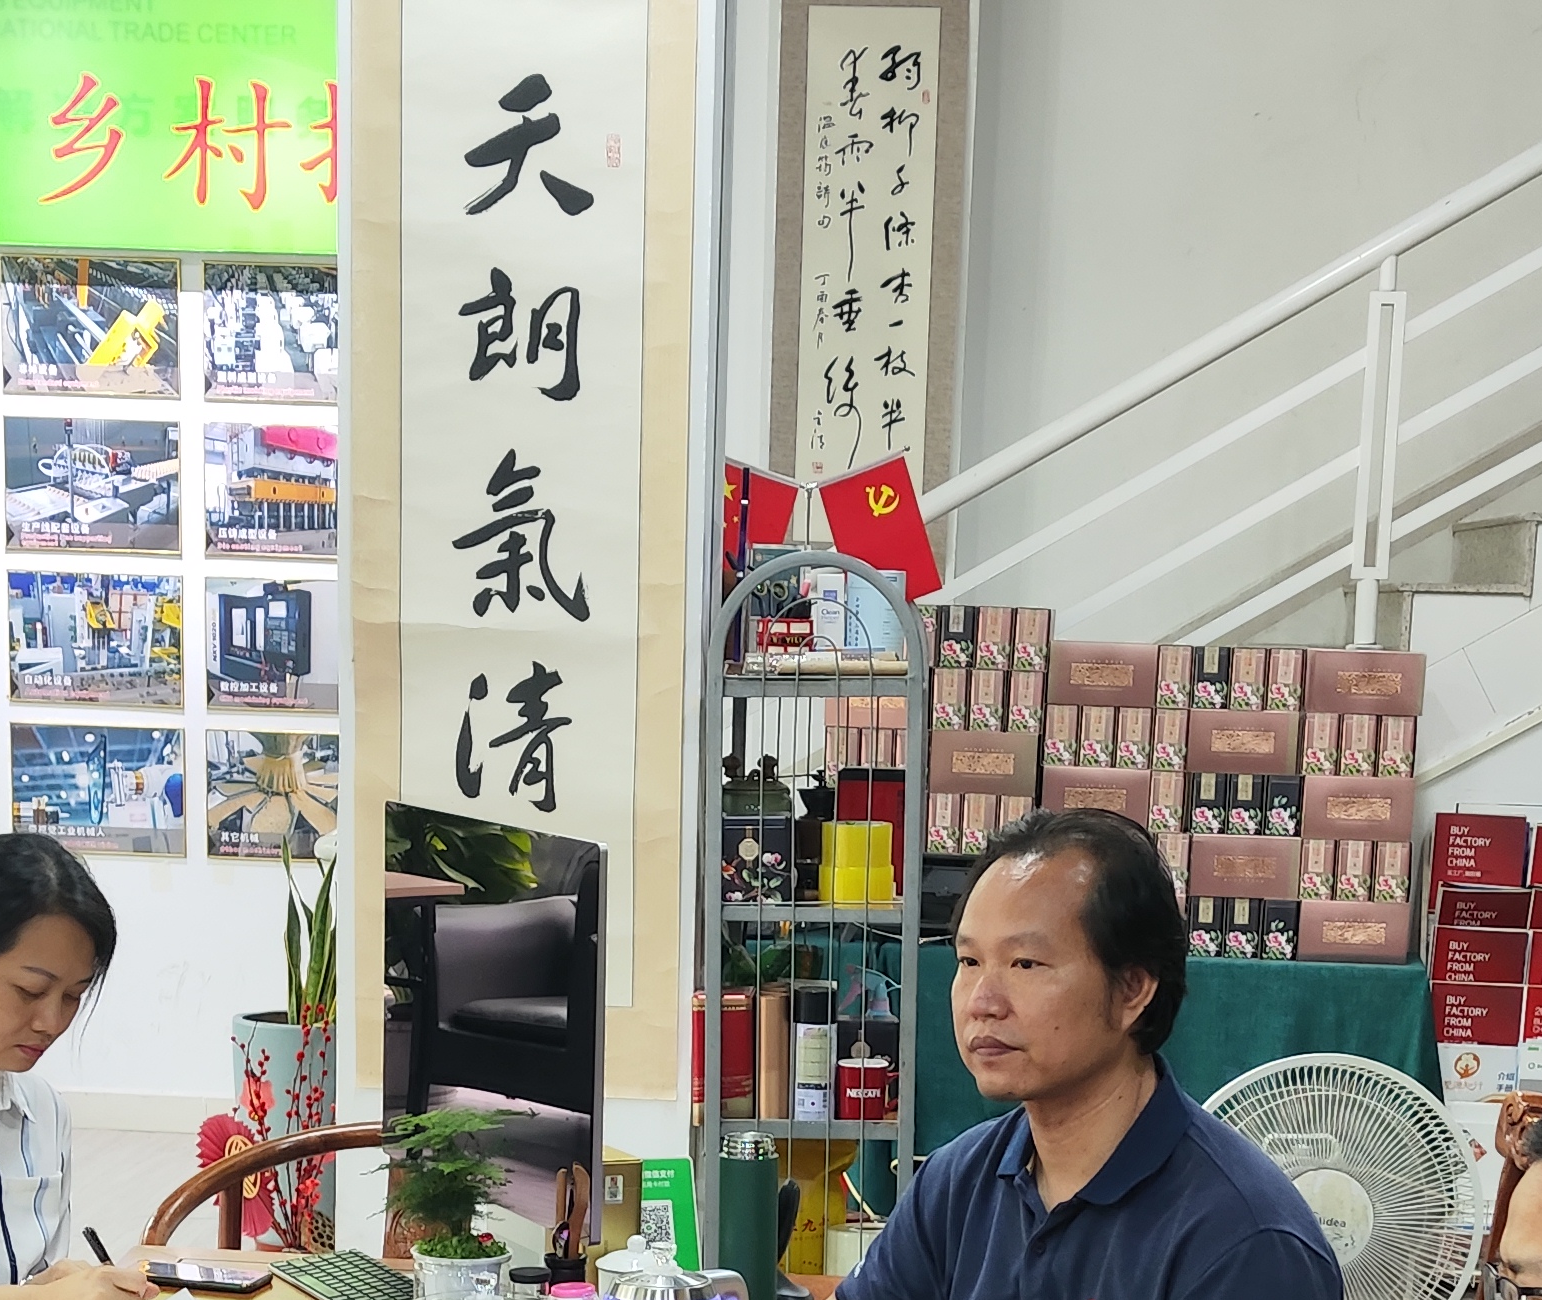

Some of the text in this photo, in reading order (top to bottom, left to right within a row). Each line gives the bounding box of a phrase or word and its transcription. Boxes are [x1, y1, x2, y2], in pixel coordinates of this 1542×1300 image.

[107, 20, 191, 44] TRADE
[197, 22, 297, 47] CENTER
[1450, 825, 1470, 836] BUY
[1448, 836, 1491, 847] FACTORY
[1447, 846, 1475, 857] FROM
[1447, 857, 1476, 868] CHINA
[1456, 901, 1477, 910] BUY
[1454, 910, 1498, 920] FACTORY
[1452, 918, 1481, 927] FROM
[1448, 940, 1470, 951] BUY
[1447, 951, 1491, 962] FACTORY
[1446, 962, 1474, 972] FROM
[1445, 972, 1475, 982] CHINA
[1445, 995, 1467, 1006] BUY
[1444, 1005, 1489, 1017] FACTORY
[1444, 1016, 1472, 1027] FROM
[1443, 1027, 1473, 1038] CHINA
